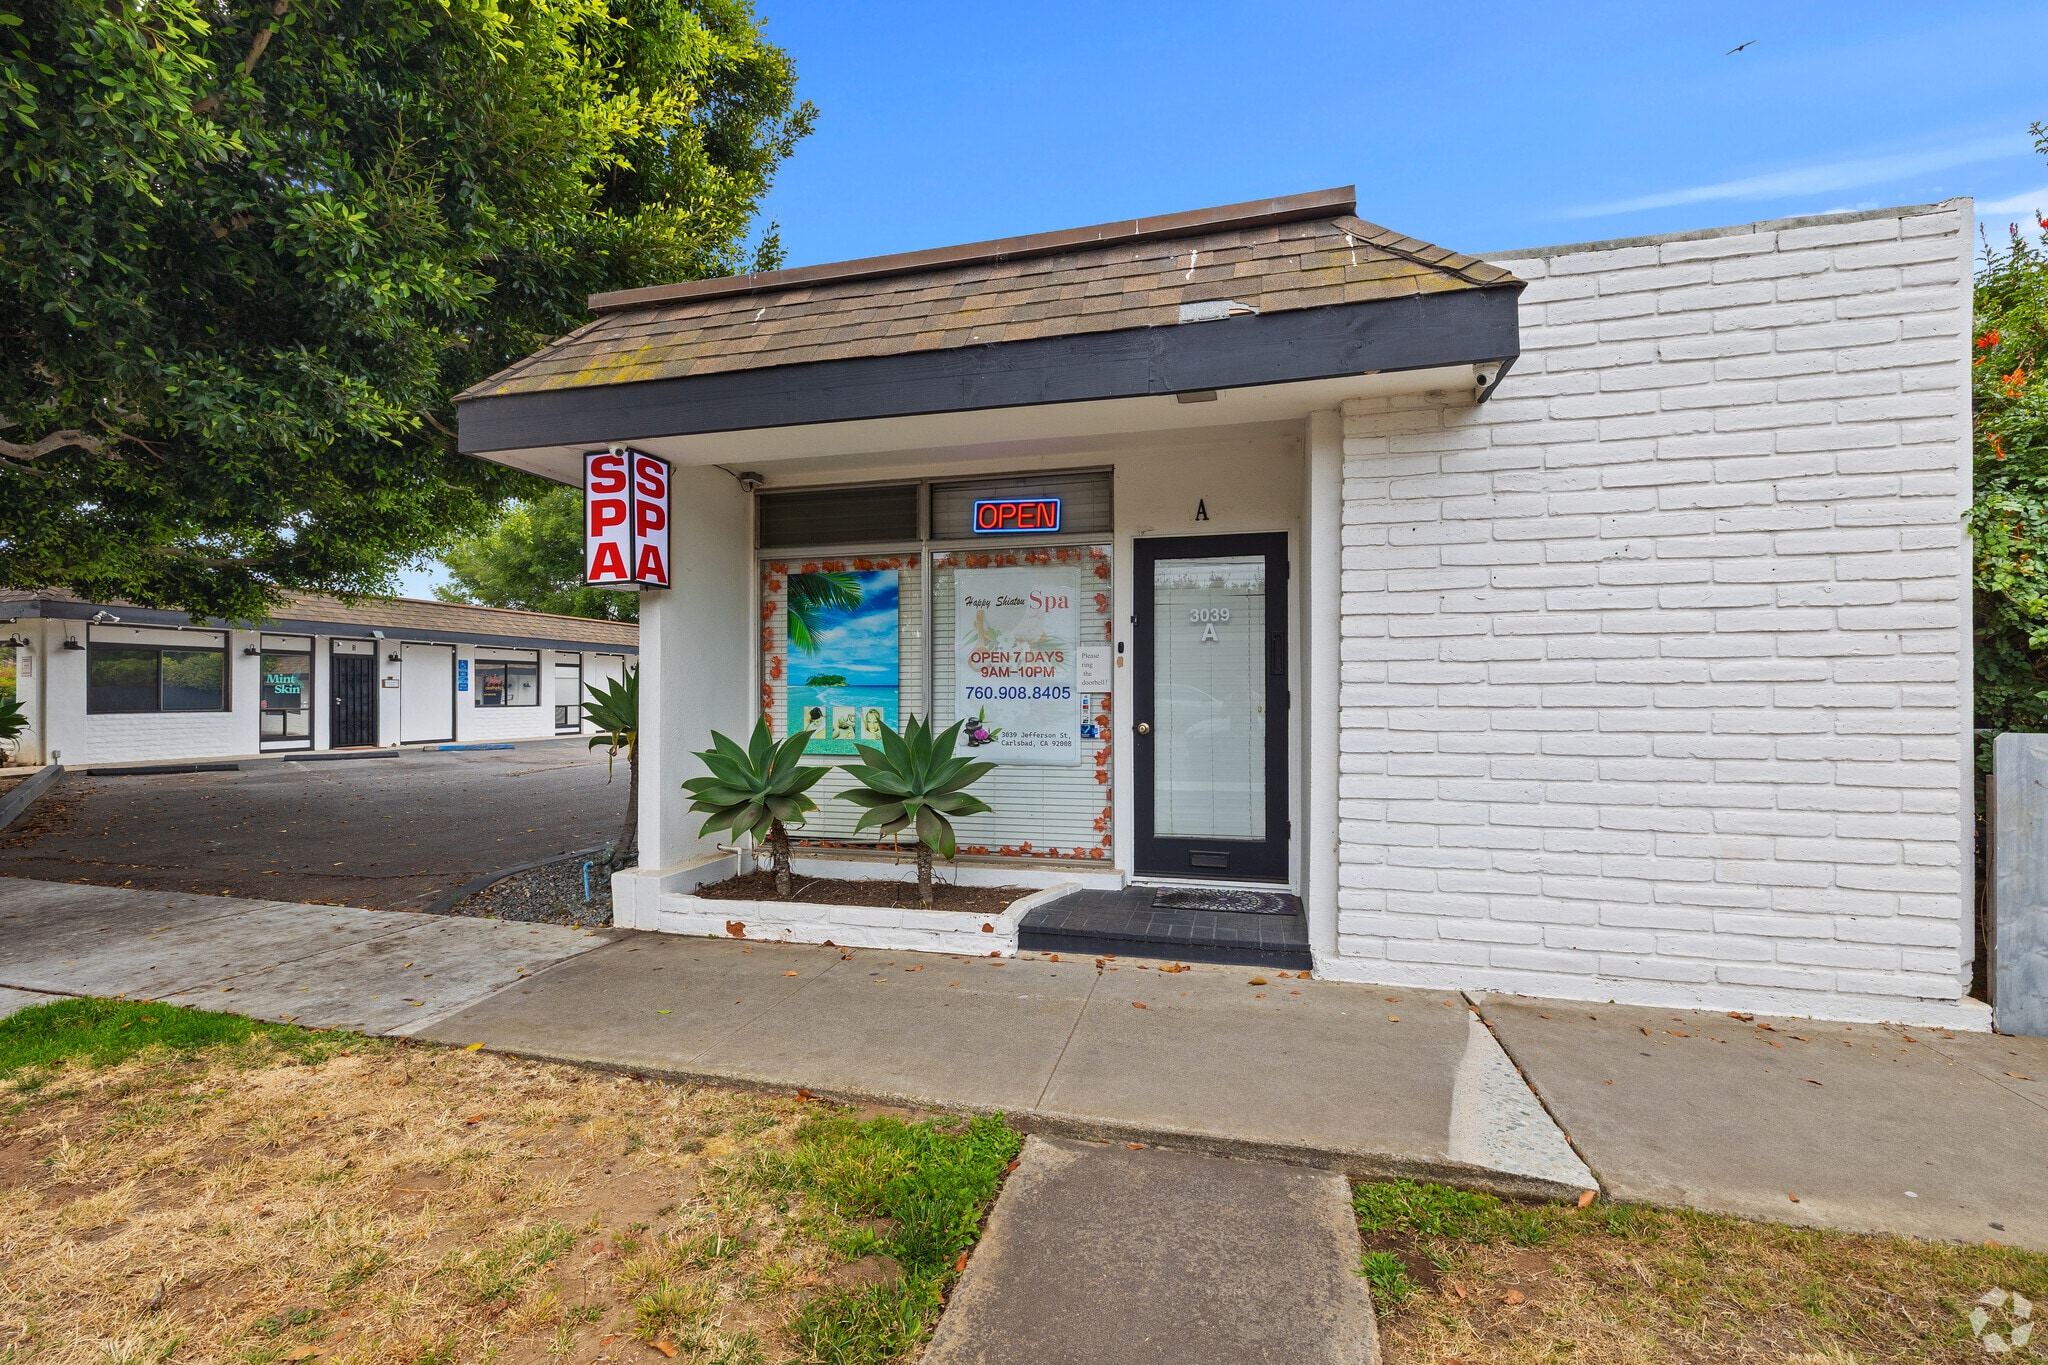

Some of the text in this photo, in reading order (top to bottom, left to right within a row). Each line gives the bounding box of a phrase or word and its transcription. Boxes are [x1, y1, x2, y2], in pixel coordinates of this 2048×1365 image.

[588, 454, 628, 580] SPA
[978, 502, 1056, 529] OPEN
[1195, 498, 1209, 521] A
[636, 457, 667, 583] SPA
[965, 596, 991, 609] Happy
[1029, 589, 1069, 612] Spa
[1190, 607, 1230, 622] 3039
[1200, 623, 1218, 642] A
[970, 651, 1064, 663] OPEN 7 DAYS
[266, 674, 296, 684] Mint
[274, 685, 300, 694] Skin
[966, 686, 1071, 700] 760.908.8405
